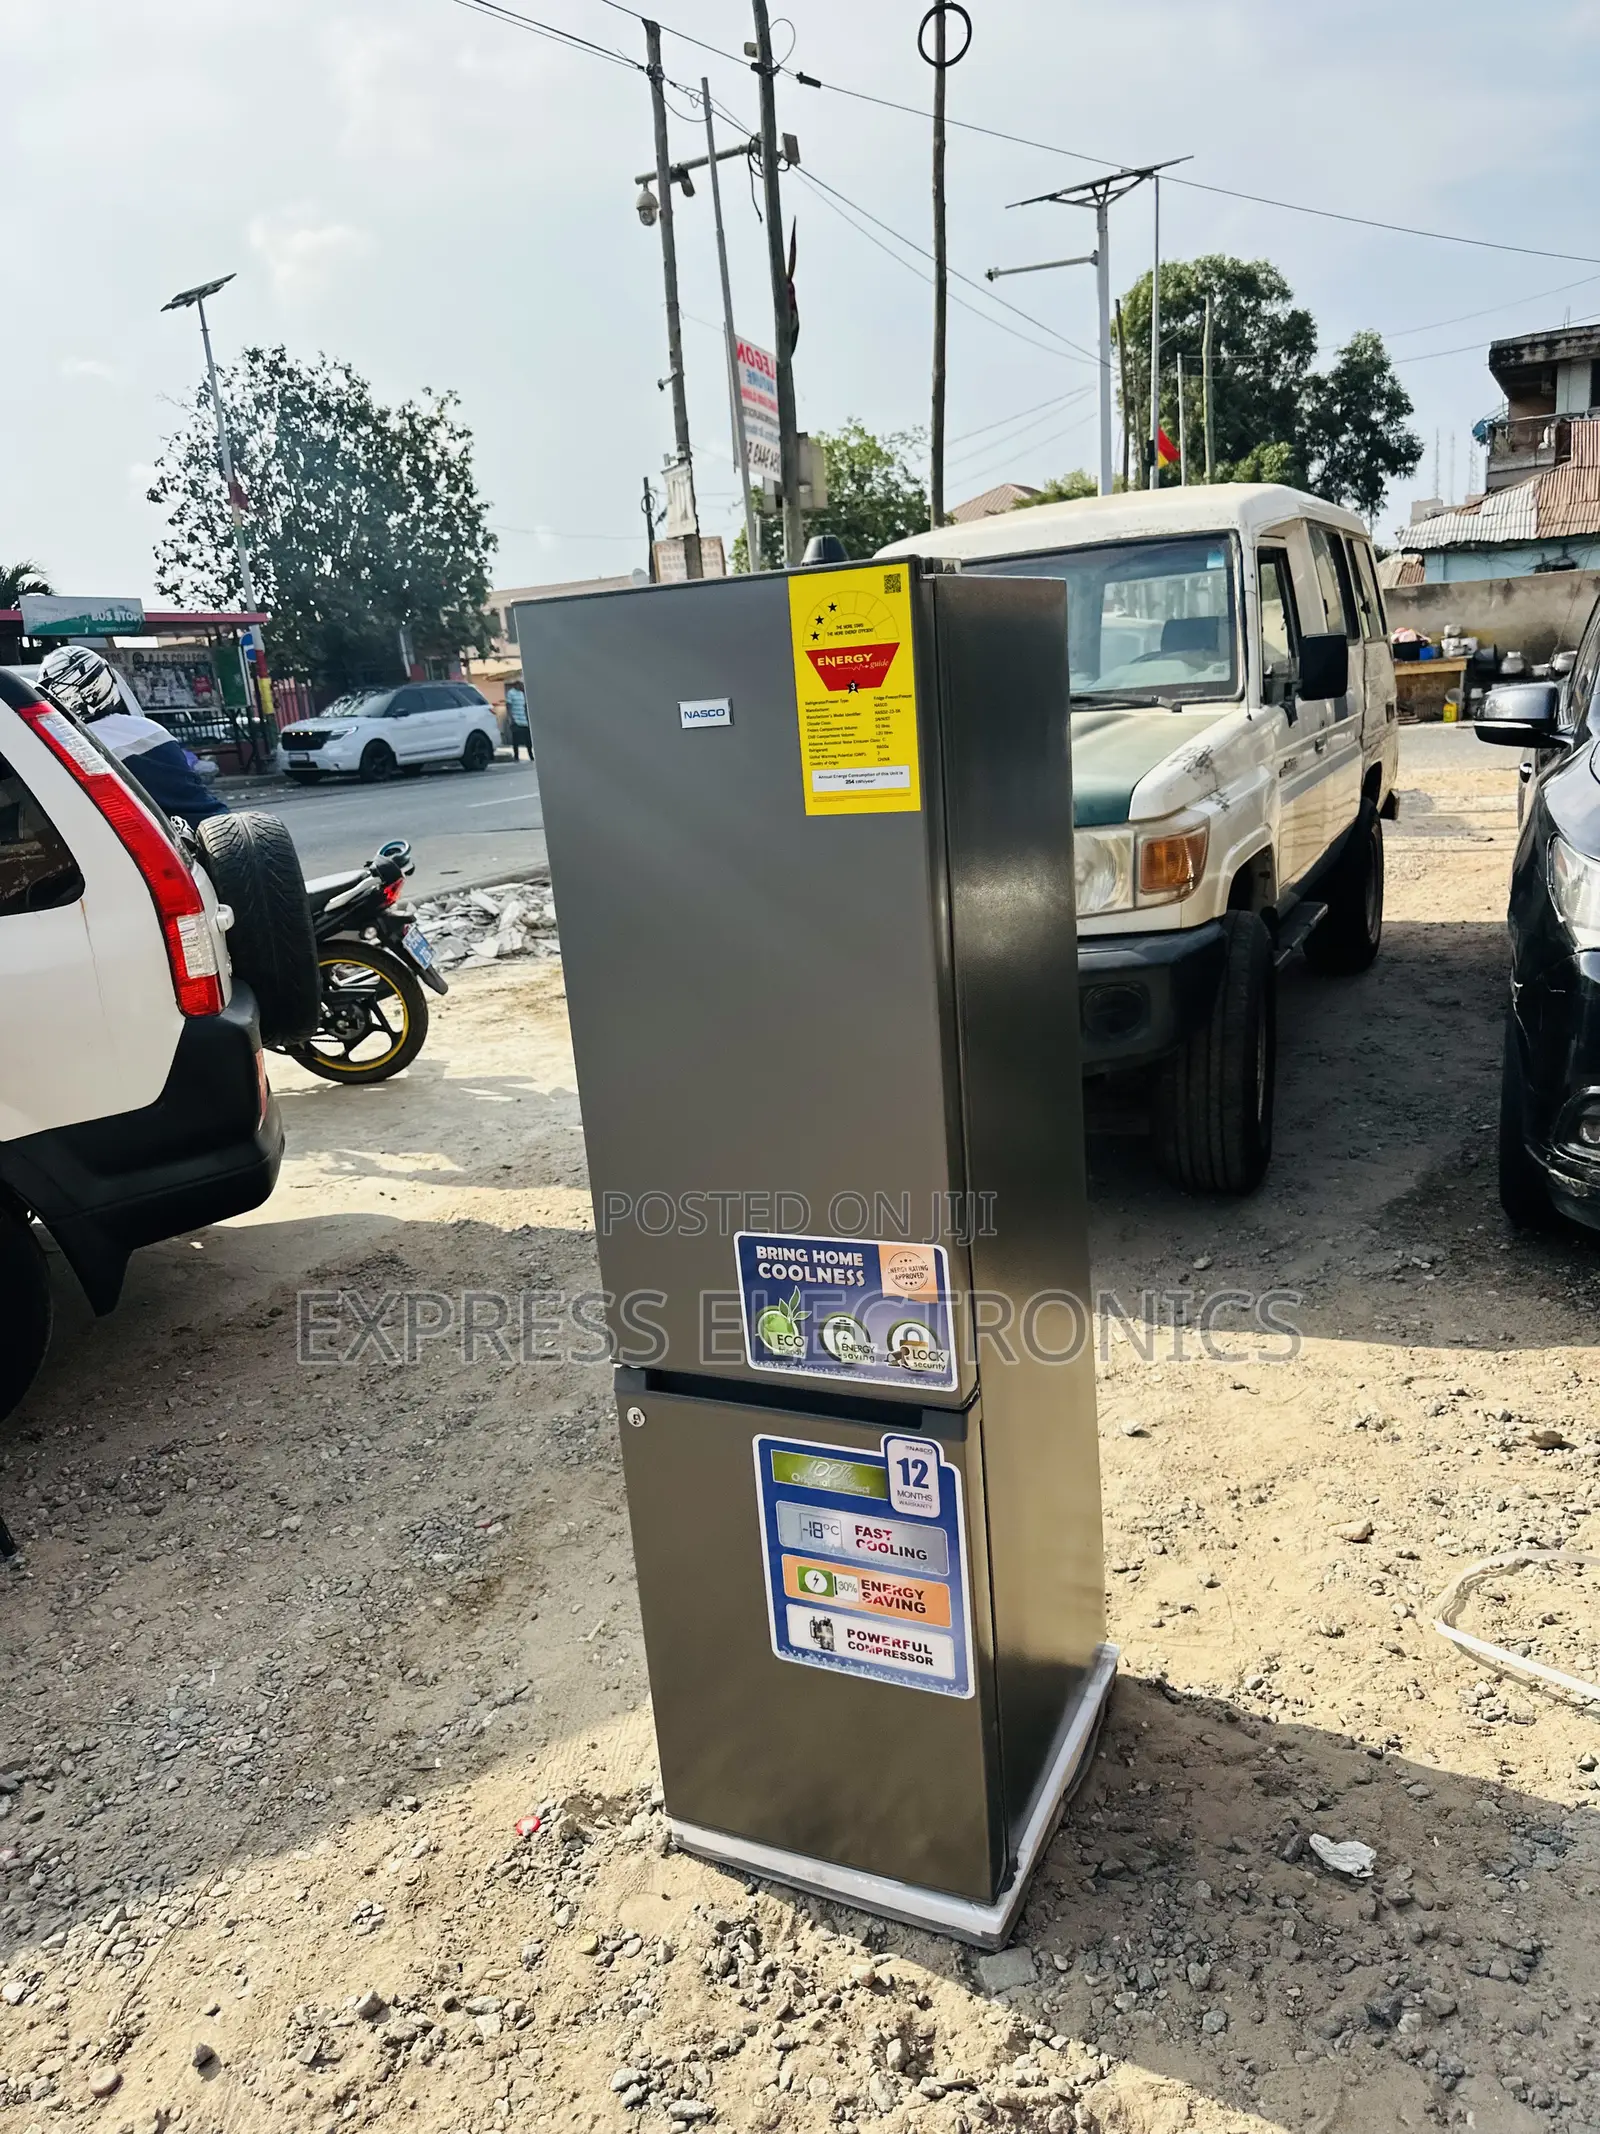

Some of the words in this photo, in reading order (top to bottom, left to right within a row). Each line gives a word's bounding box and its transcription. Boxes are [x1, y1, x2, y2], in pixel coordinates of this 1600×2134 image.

[817, 653, 873, 668] ENERGY
[869, 659, 889, 669] guide
[684, 708, 726, 719] NASCO
[756, 1246, 808, 1262] BRING
[812, 1250, 864, 1266] HOME
[758, 1263, 865, 1287] COOLNESS
[895, 1272, 924, 1280] APPROVED
[777, 1334, 805, 1347] ECO
[842, 1343, 875, 1354] ENERGY
[912, 1350, 944, 1362] LOCK
[913, 1362, 946, 1371] security
[909, 1445, 933, 1454] NASCO
[896, 1458, 929, 1489] 12
[897, 1490, 933, 1502] MONTHS
[899, 1501, 932, 1510] WARRANTY
[855, 1525, 893, 1541] FAST
[856, 1539, 928, 1560] COOLING
[838, 1580, 858, 1594] 30%
[861, 1579, 925, 1600] ENERGY
[862, 1592, 926, 1614] SAVING
[847, 1628, 933, 1655] POWERFUL
[848, 1641, 934, 1666] COMPRESSOR
